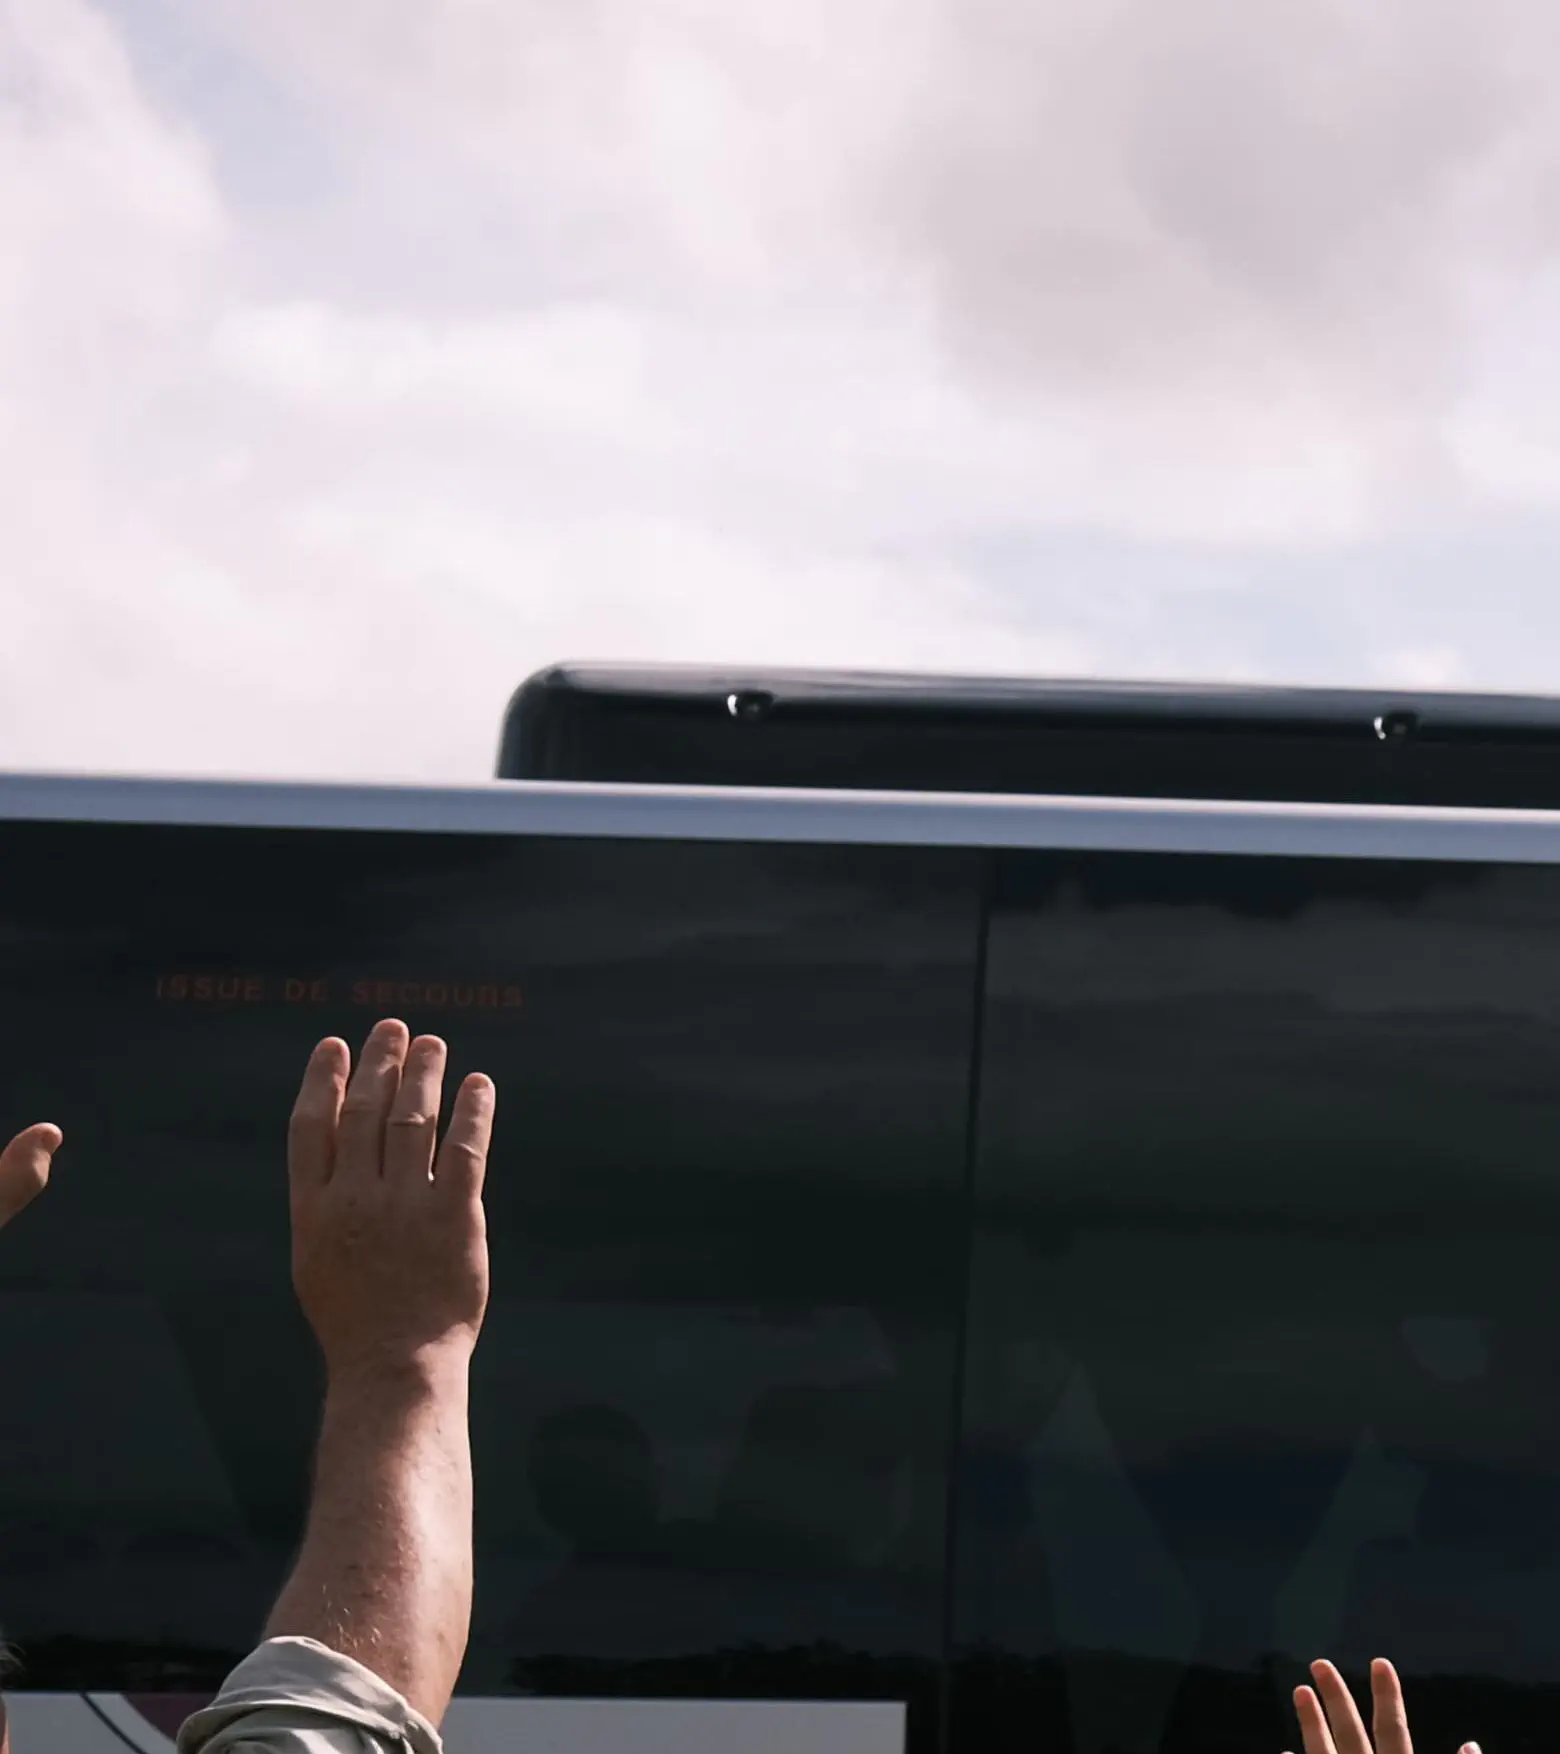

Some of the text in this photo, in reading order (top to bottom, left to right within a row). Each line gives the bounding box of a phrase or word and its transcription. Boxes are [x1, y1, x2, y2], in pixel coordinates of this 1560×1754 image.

[156, 974, 524, 1008] ISSUE DE SECOURS
